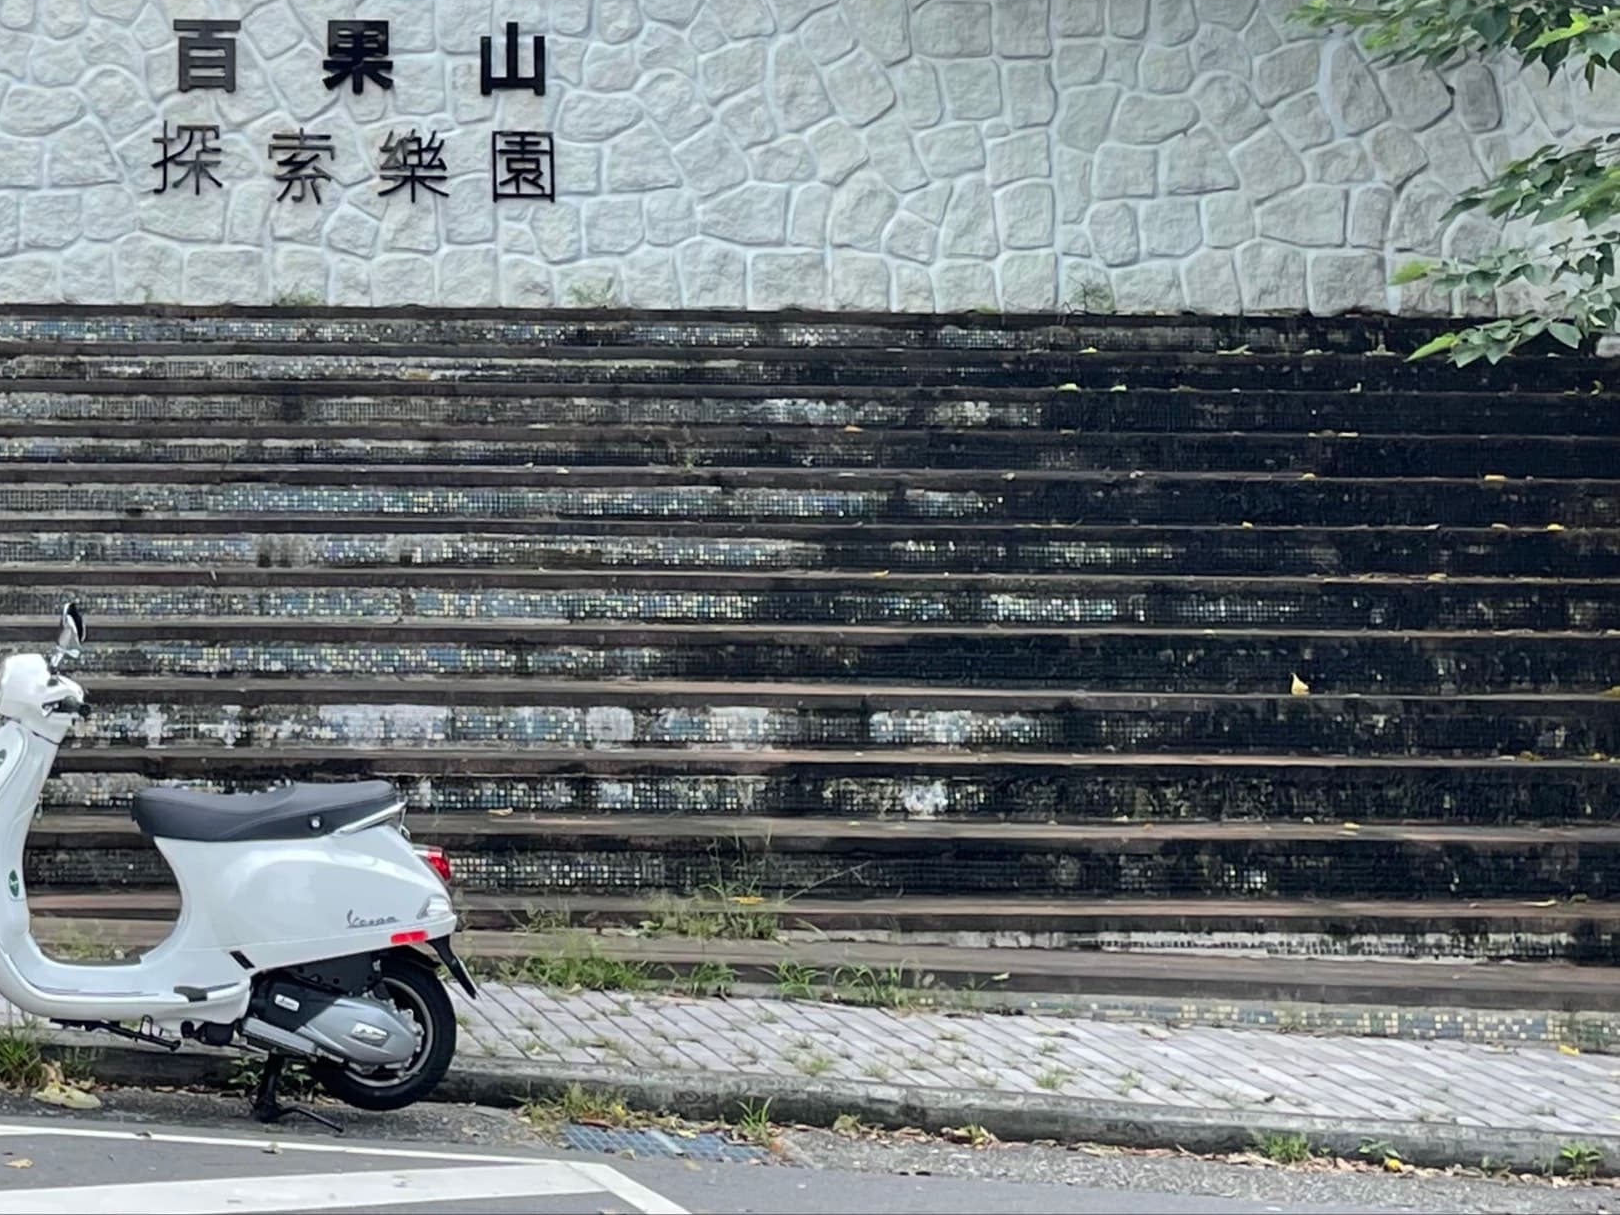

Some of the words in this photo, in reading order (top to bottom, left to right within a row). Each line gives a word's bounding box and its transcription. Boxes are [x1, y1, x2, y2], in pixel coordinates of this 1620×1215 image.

[173, 18, 546, 96] 百果山
[151, 121, 556, 204] 探索樂園
